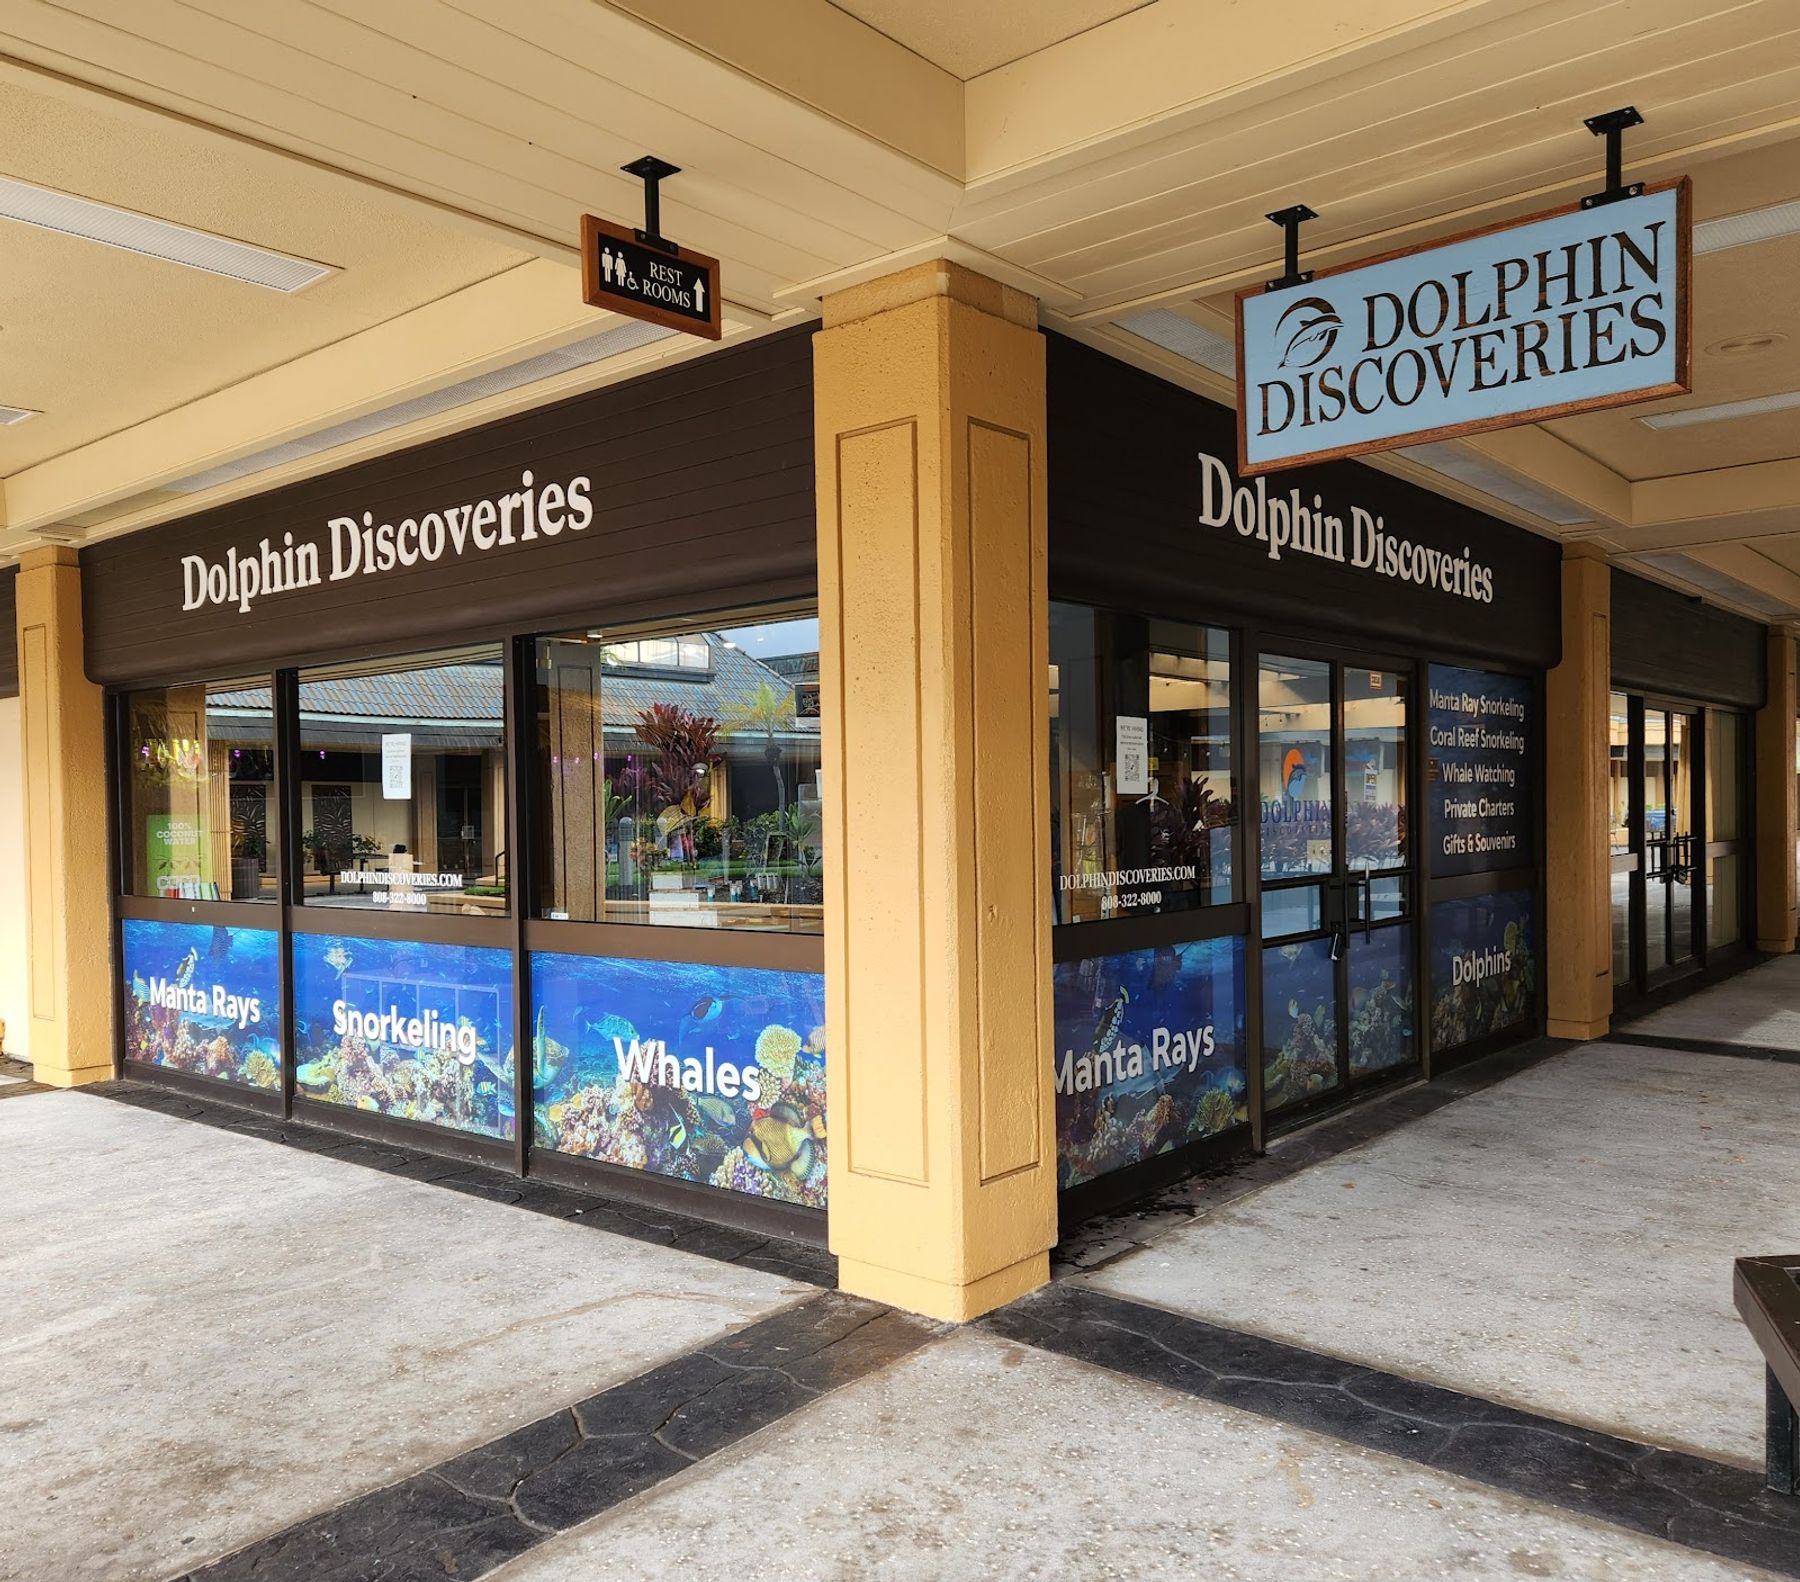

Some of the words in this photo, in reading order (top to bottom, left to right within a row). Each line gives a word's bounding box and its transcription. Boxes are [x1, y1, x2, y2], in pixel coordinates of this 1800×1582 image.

[650, 261, 683, 287] REST
[1362, 220, 1667, 353] DOLPHIN
[643, 279, 691, 309] ROOMS
[1256, 292, 1667, 436] DISCOVERIES
[181, 531, 321, 613] Dolphin
[327, 469, 593, 582] Discoveries
[1198, 452, 1345, 560] Dolphin
[1350, 506, 1494, 604] Discoveries
[1429, 688, 1460, 711] Manta
[1461, 692, 1479, 718] Ray
[1480, 695, 1525, 722] Snorkeling
[1430, 726, 1456, 746] Coral
[1458, 728, 1480, 747] Reef
[1481, 730, 1525, 755] Snorkeling
[1442, 762, 1473, 783] Whale
[1474, 763, 1515, 788] Watching
[1444, 798, 1477, 819] Private
[1478, 798, 1515, 818] Charters
[1443, 834, 1466, 855] Gifts
[1467, 834, 1475, 853] &
[1475, 831, 1516, 852] Souvenirs
[340, 870, 463, 888] DOLPHINDISCOVERIES.COM
[1060, 865, 1196, 891] DOLPHINDISCOVERIES.COM
[1101, 891, 1162, 910] 808-322-8000
[1453, 945, 1512, 988] Dolphins
[150, 976, 207, 1014] Manta
[212, 985, 260, 1029] Rays
[333, 1000, 476, 1065] Snorkeling
[613, 1036, 761, 1101] Whales
[1054, 1039, 1143, 1096] Manta
[1152, 1025, 1215, 1073] Rays
